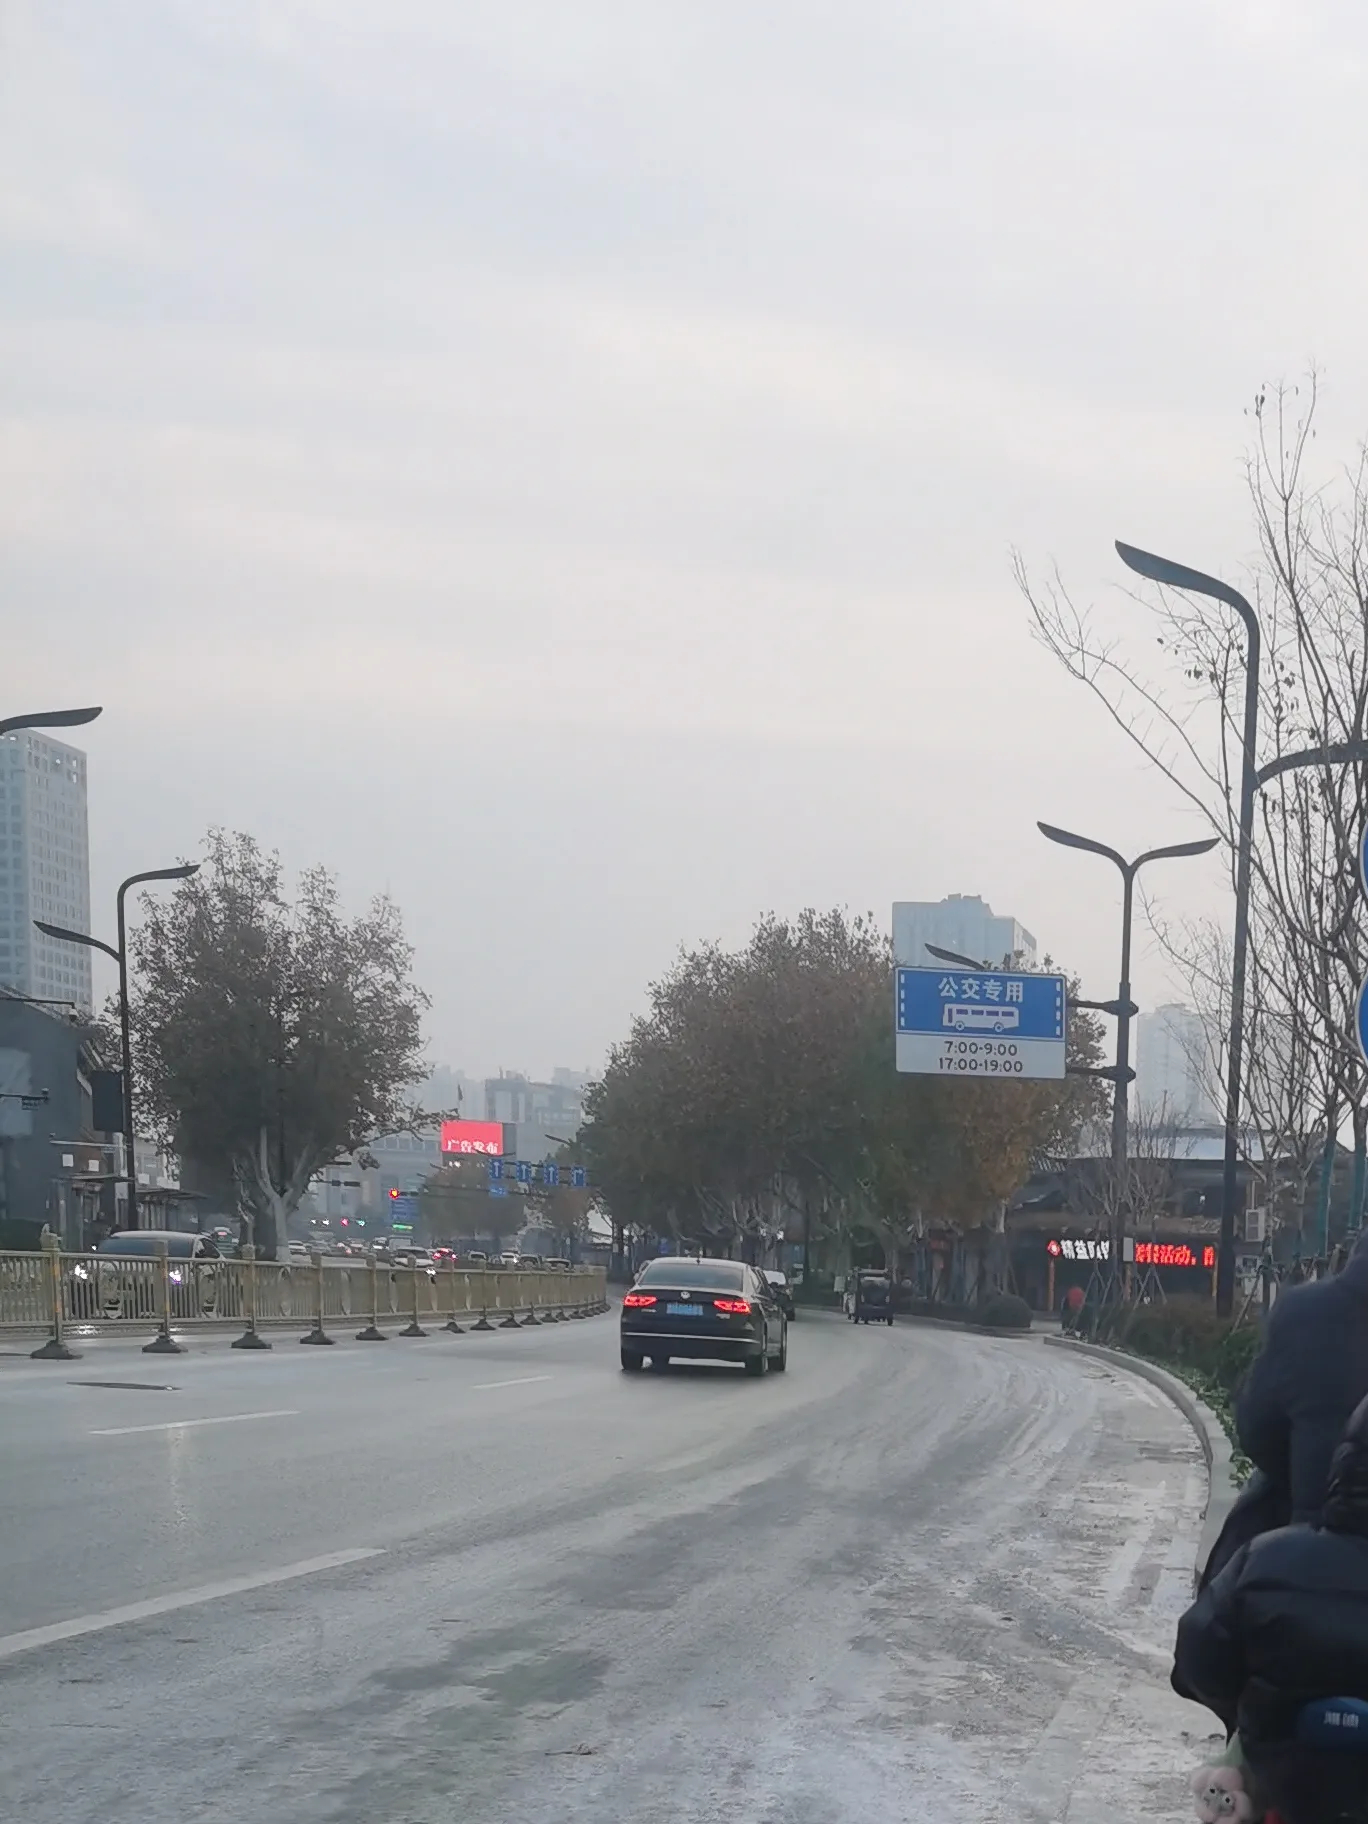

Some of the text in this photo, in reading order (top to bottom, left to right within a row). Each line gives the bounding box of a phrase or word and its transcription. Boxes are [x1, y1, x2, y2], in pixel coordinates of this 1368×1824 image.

[938, 976, 1024, 1003] 公交专用
[943, 1040, 1018, 1057] 7:00-9:00
[938, 1057, 1024, 1073] 17:00-19:00
[447, 1138, 499, 1154] 广告发布
